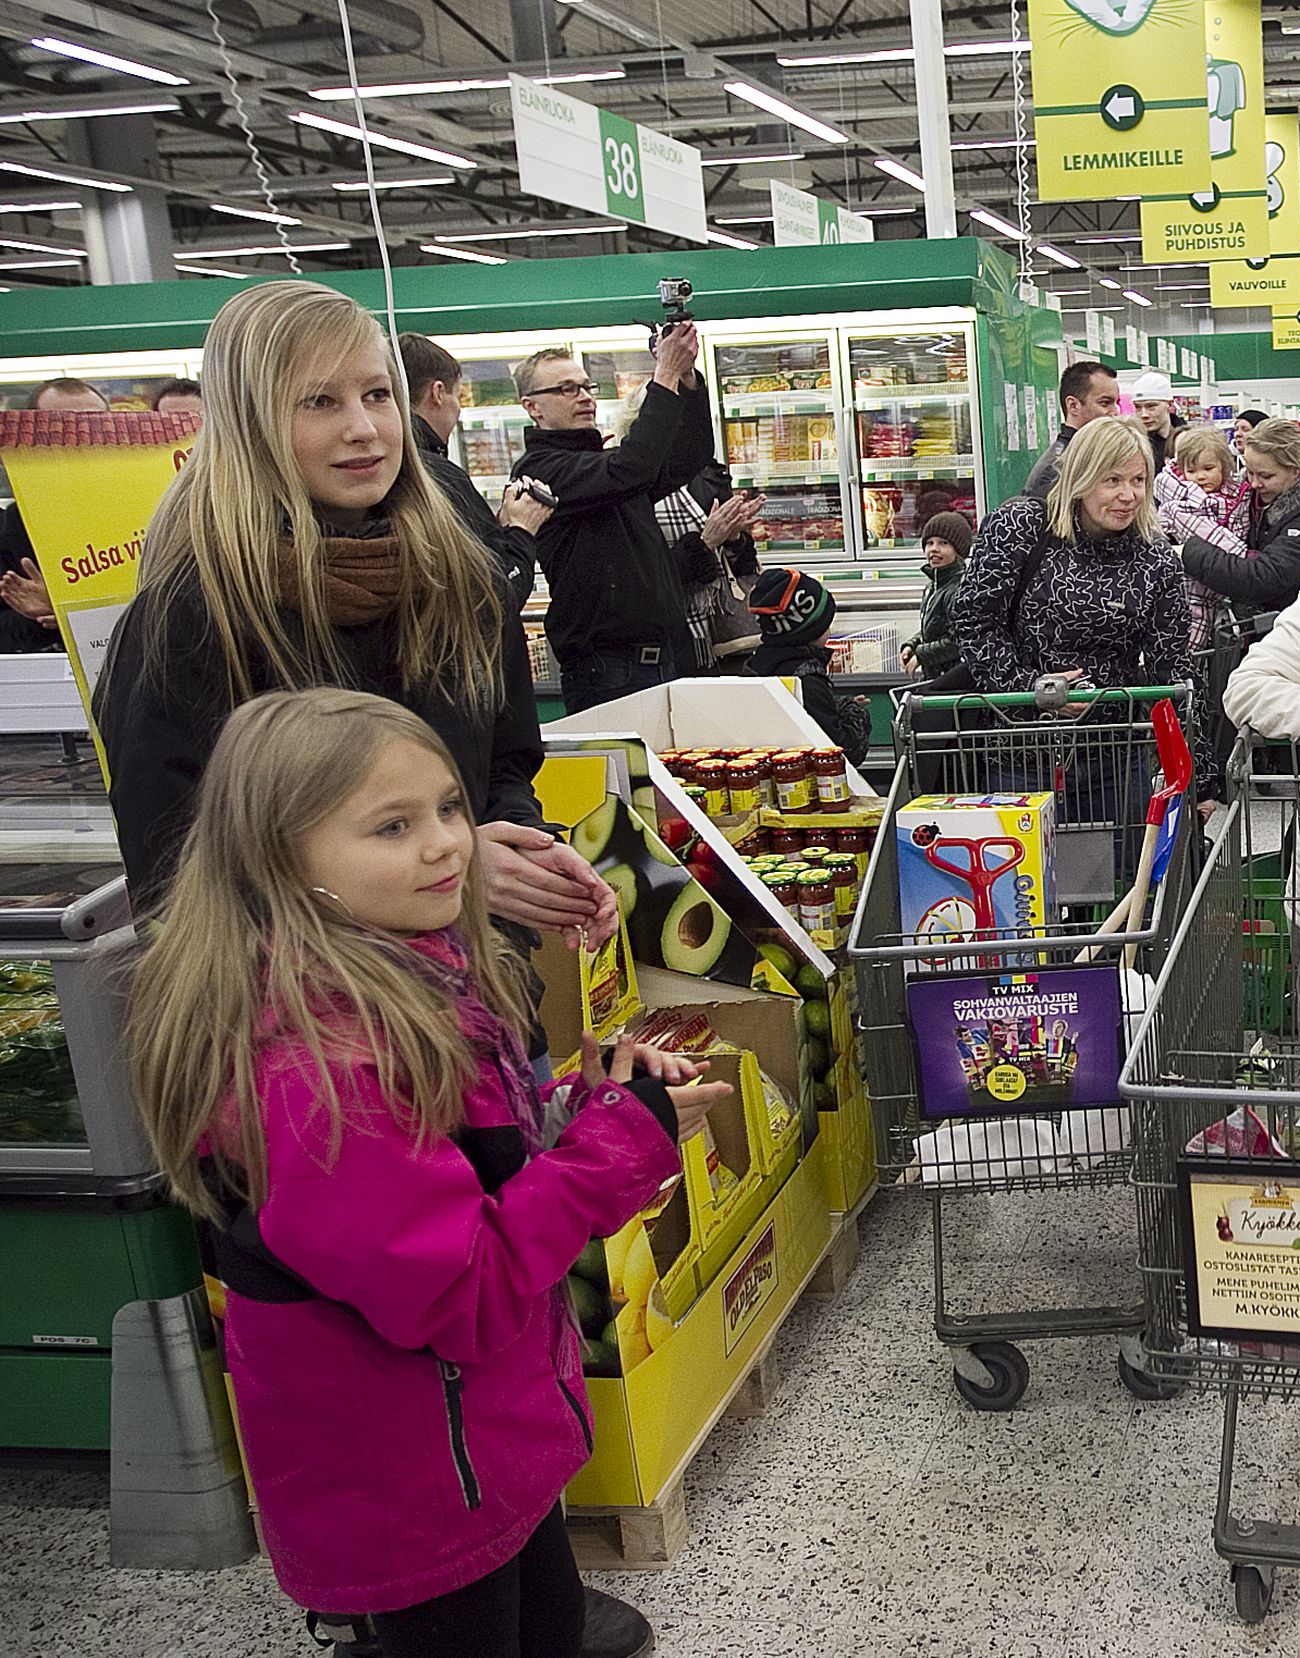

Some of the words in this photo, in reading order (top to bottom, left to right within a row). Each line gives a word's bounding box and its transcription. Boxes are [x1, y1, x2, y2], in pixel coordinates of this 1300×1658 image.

[1063, 149, 1184, 171] LEMMIKEILLE
[604, 136, 639, 200] 38
[1165, 222, 1223, 237] SIIVOUS
[1228, 222, 1245, 234] JA
[1166, 236, 1246, 251] PUHDISTUS
[1228, 279, 1287, 291] VAUVOILLE
[61, 544, 125, 584] Salsa
[992, 985, 1008, 995] TV
[1011, 984, 1034, 994] MIX
[953, 992, 1078, 1011] SOHVANVALTAAJIEN
[954, 1002, 1079, 1021] VAKIOVARUSTE
[1203, 1261, 1276, 1276] OSTOSLISTAT
[1216, 1277, 1248, 1288] MENE
[1212, 1289, 1256, 1299] NETTIIN
